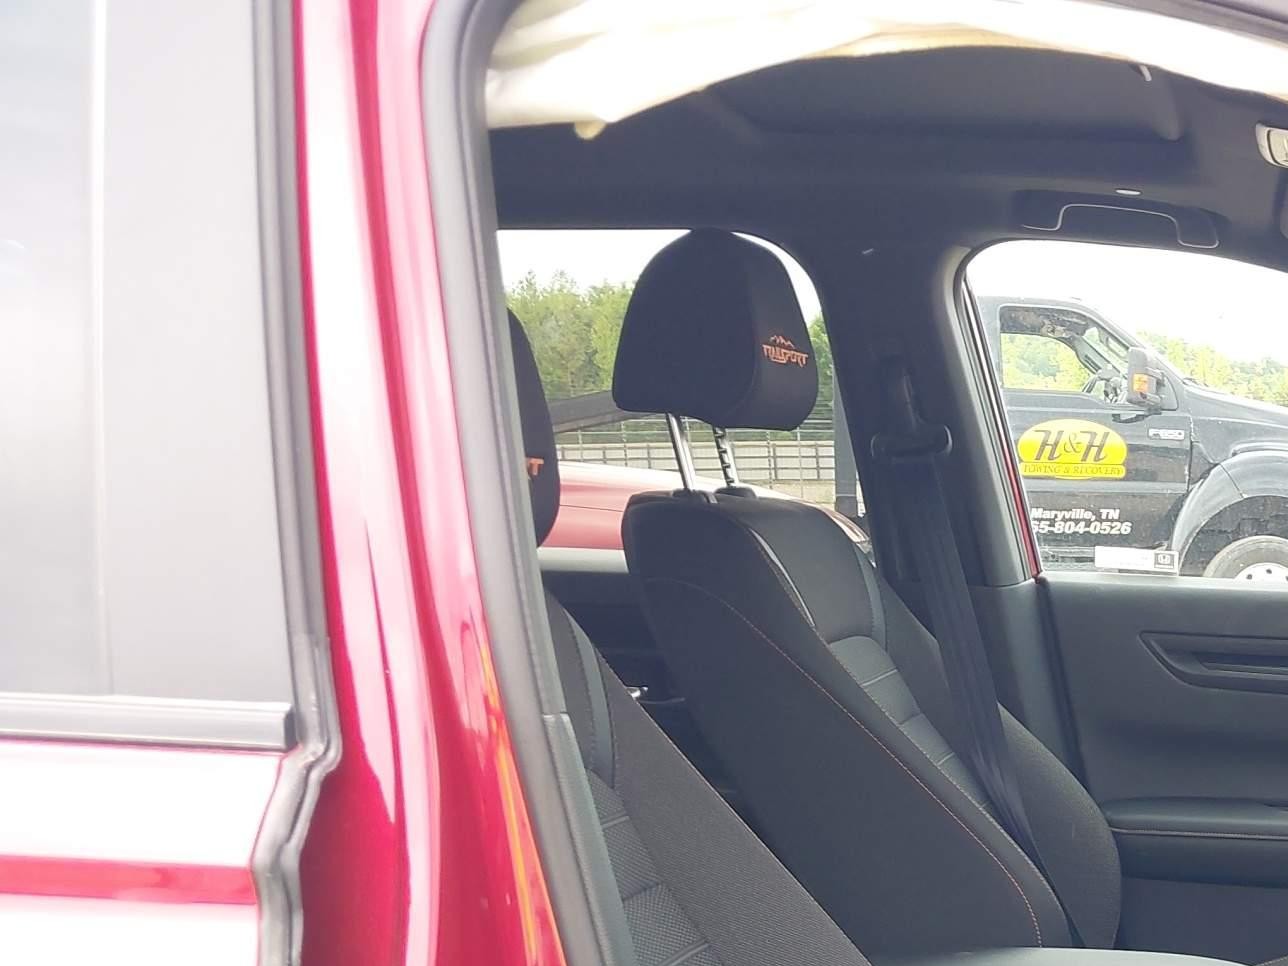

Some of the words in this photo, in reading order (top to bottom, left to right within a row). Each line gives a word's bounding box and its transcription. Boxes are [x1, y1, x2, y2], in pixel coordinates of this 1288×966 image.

[1034, 429, 1110, 462] H&H
[1031, 508, 1097, 521] Maryville,
[1100, 508, 1120, 520] TN
